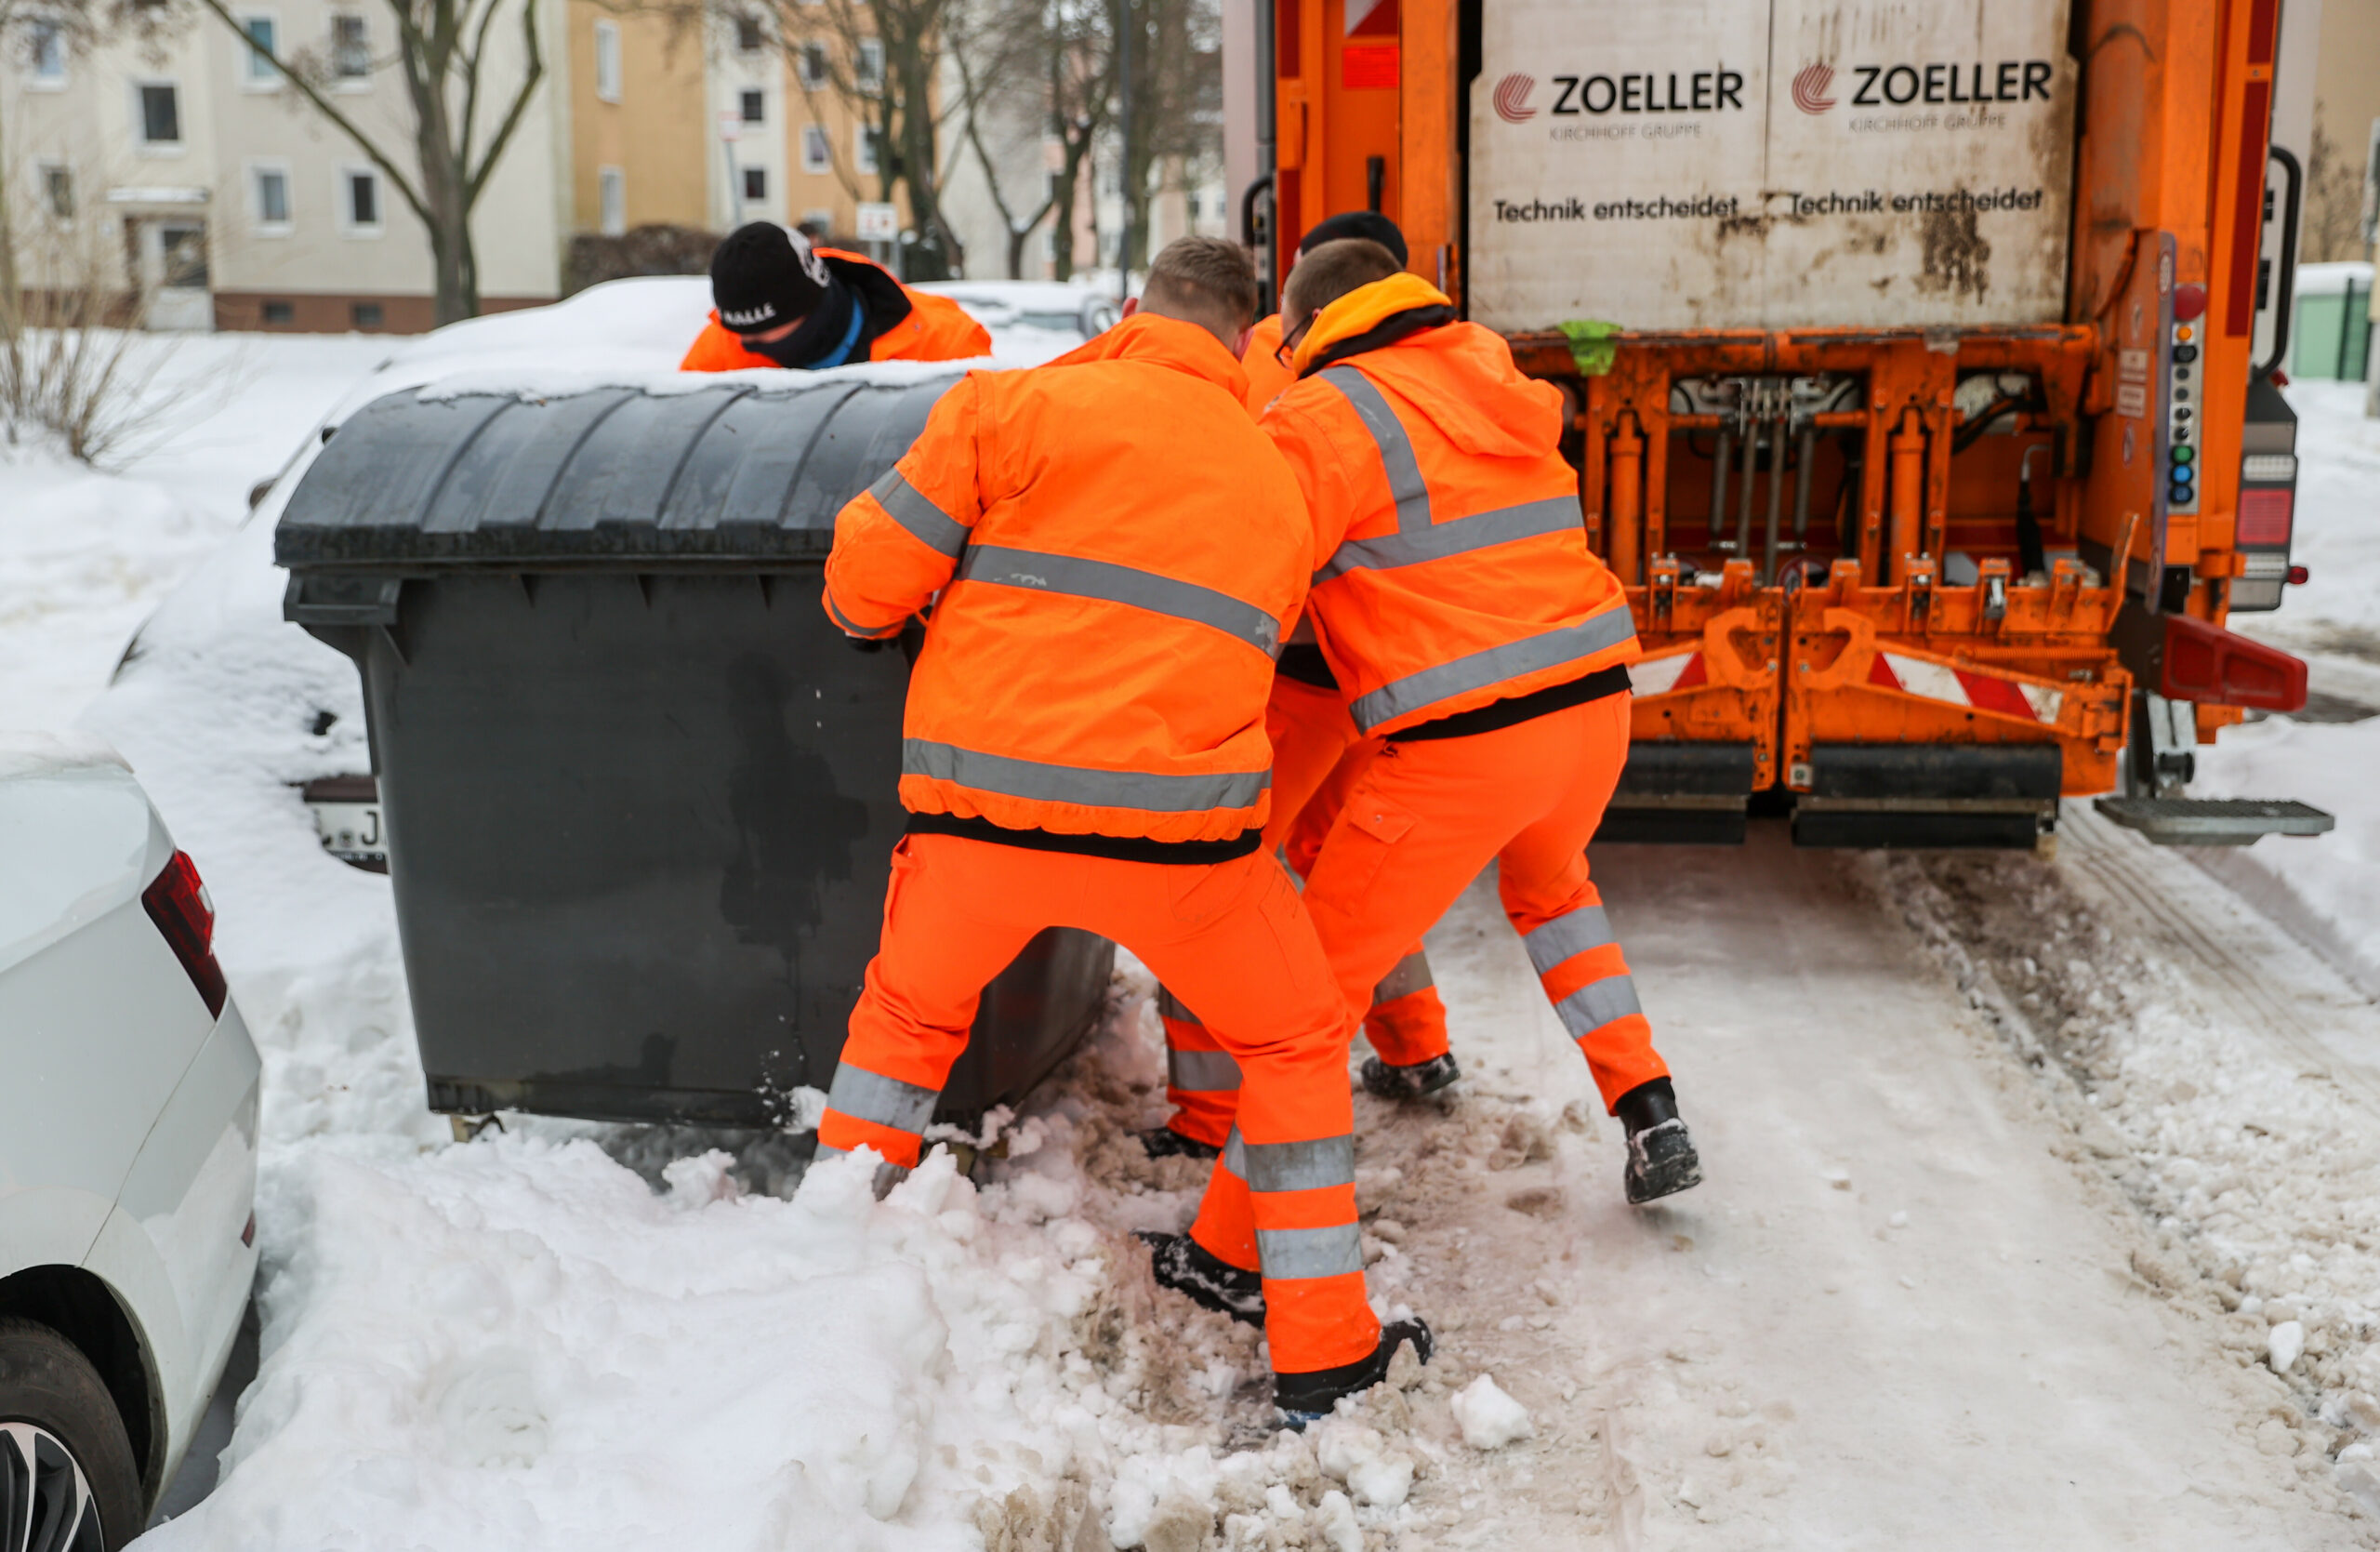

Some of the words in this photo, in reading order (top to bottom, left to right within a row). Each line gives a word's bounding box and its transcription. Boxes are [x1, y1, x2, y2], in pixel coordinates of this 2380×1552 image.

[1552, 72, 1744, 114] ZOELLER
[1851, 61, 2053, 106] ZOELLER
[1549, 124, 1635, 141] KIRCHHOFF
[1641, 122, 1702, 139] GRUPPE
[1848, 115, 1938, 133] KIRCHHOFF
[1944, 113, 2006, 130] GRUPPE
[1494, 196, 1584, 222] Technik
[1593, 194, 1739, 219] entscheidet
[1791, 189, 1883, 216] Technik
[1891, 187, 2043, 213] entscheidet
